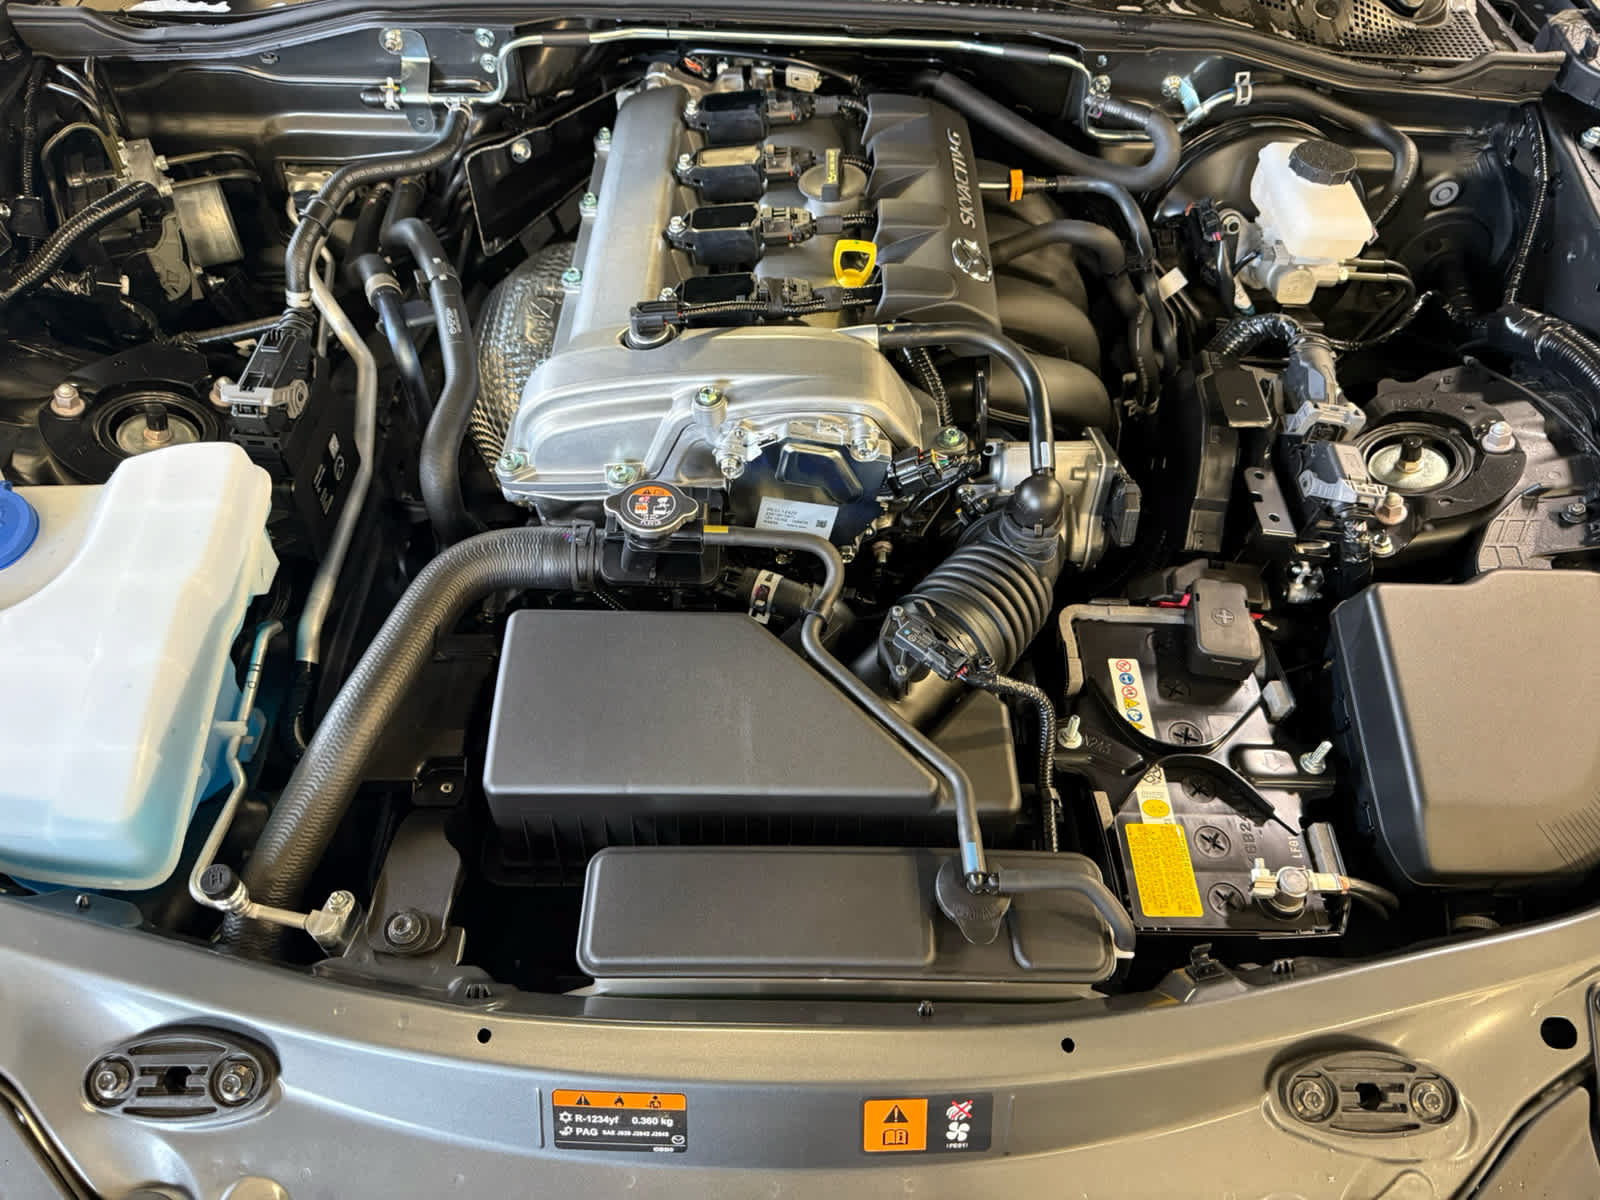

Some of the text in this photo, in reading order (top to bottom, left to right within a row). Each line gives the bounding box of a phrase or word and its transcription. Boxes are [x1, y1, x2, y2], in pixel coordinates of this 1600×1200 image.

[946, 127, 976, 229] SKYACTIV-G
[574, 1113, 619, 1126] R-1234yf
[660, 1116, 674, 1127] kg
[575, 1127, 599, 1137] PAG
